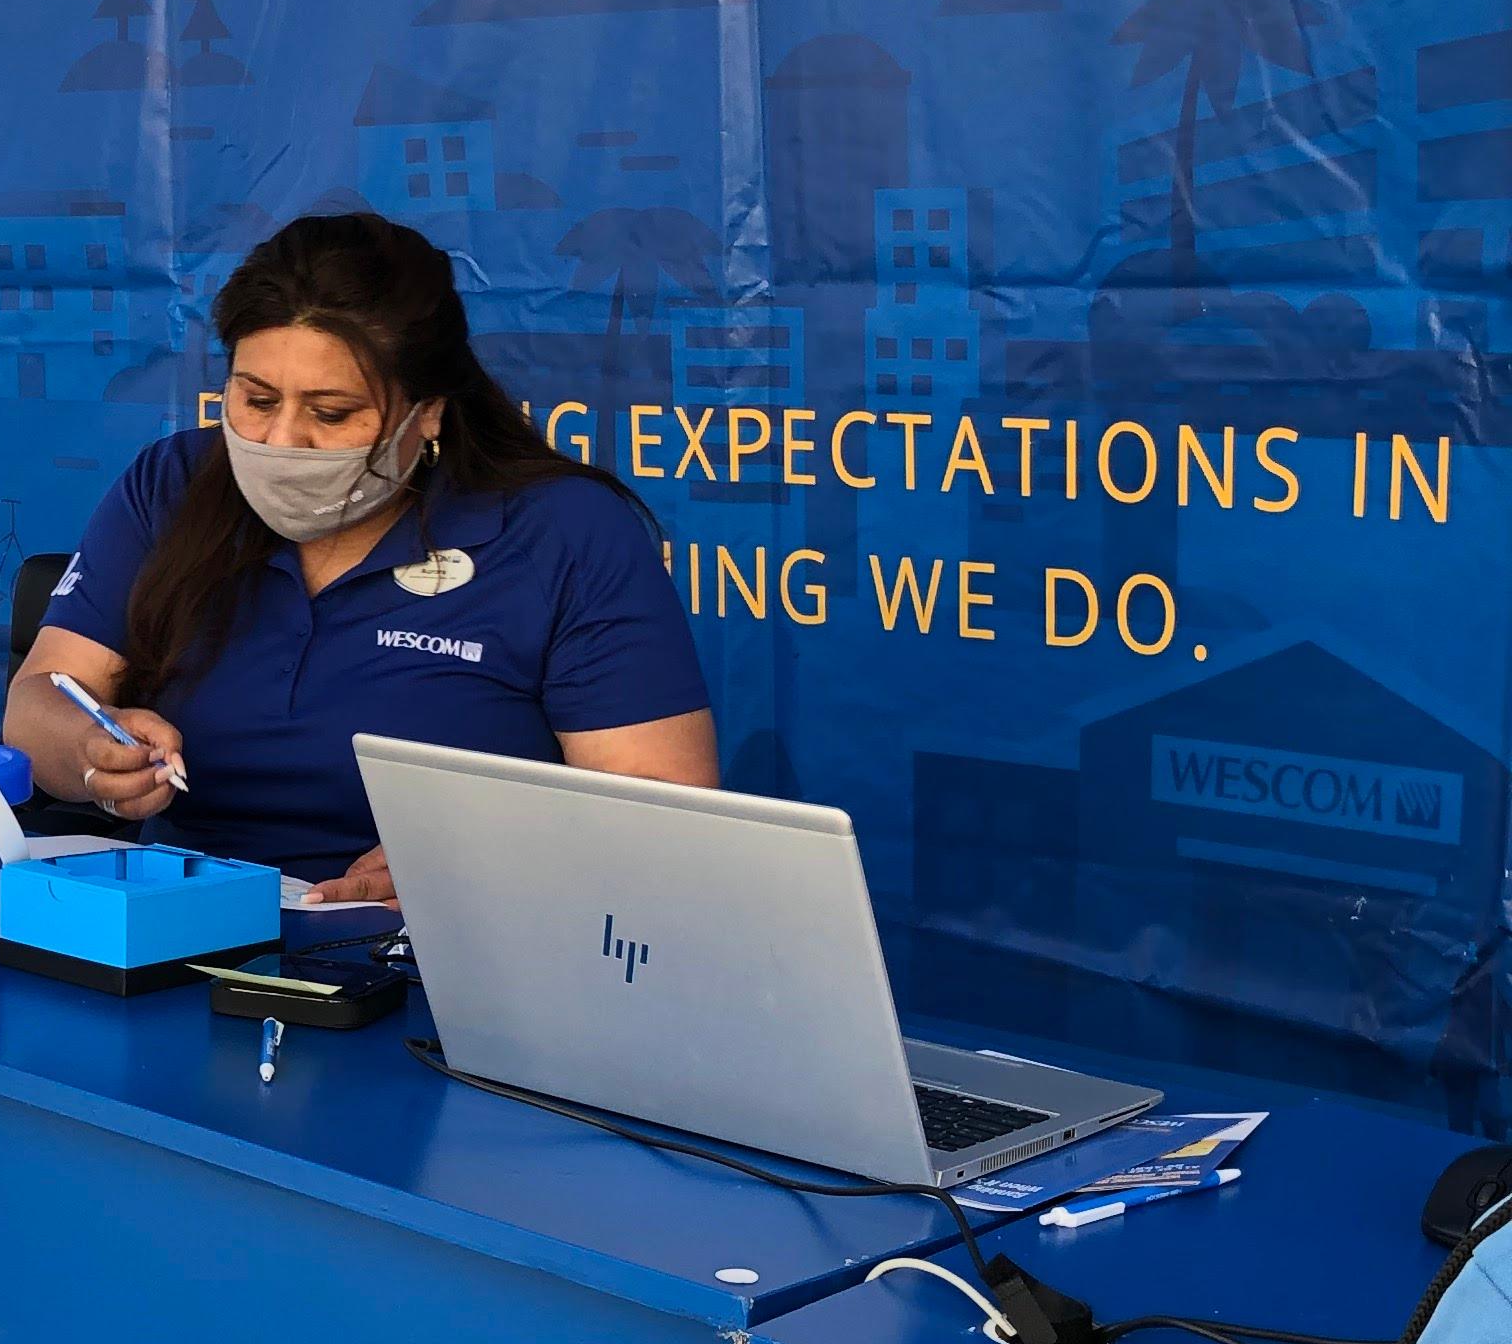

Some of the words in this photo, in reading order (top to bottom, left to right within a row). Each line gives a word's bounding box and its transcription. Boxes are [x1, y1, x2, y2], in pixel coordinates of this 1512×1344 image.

[630, 404, 1301, 513] EXPECTATIONS
[1352, 432, 1450, 523] IN
[377, 629, 461, 657] WESCOM
[869, 554, 995, 641] WE
[1045, 567, 1207, 662] DO.
[1169, 750, 1384, 822] WESCOM
